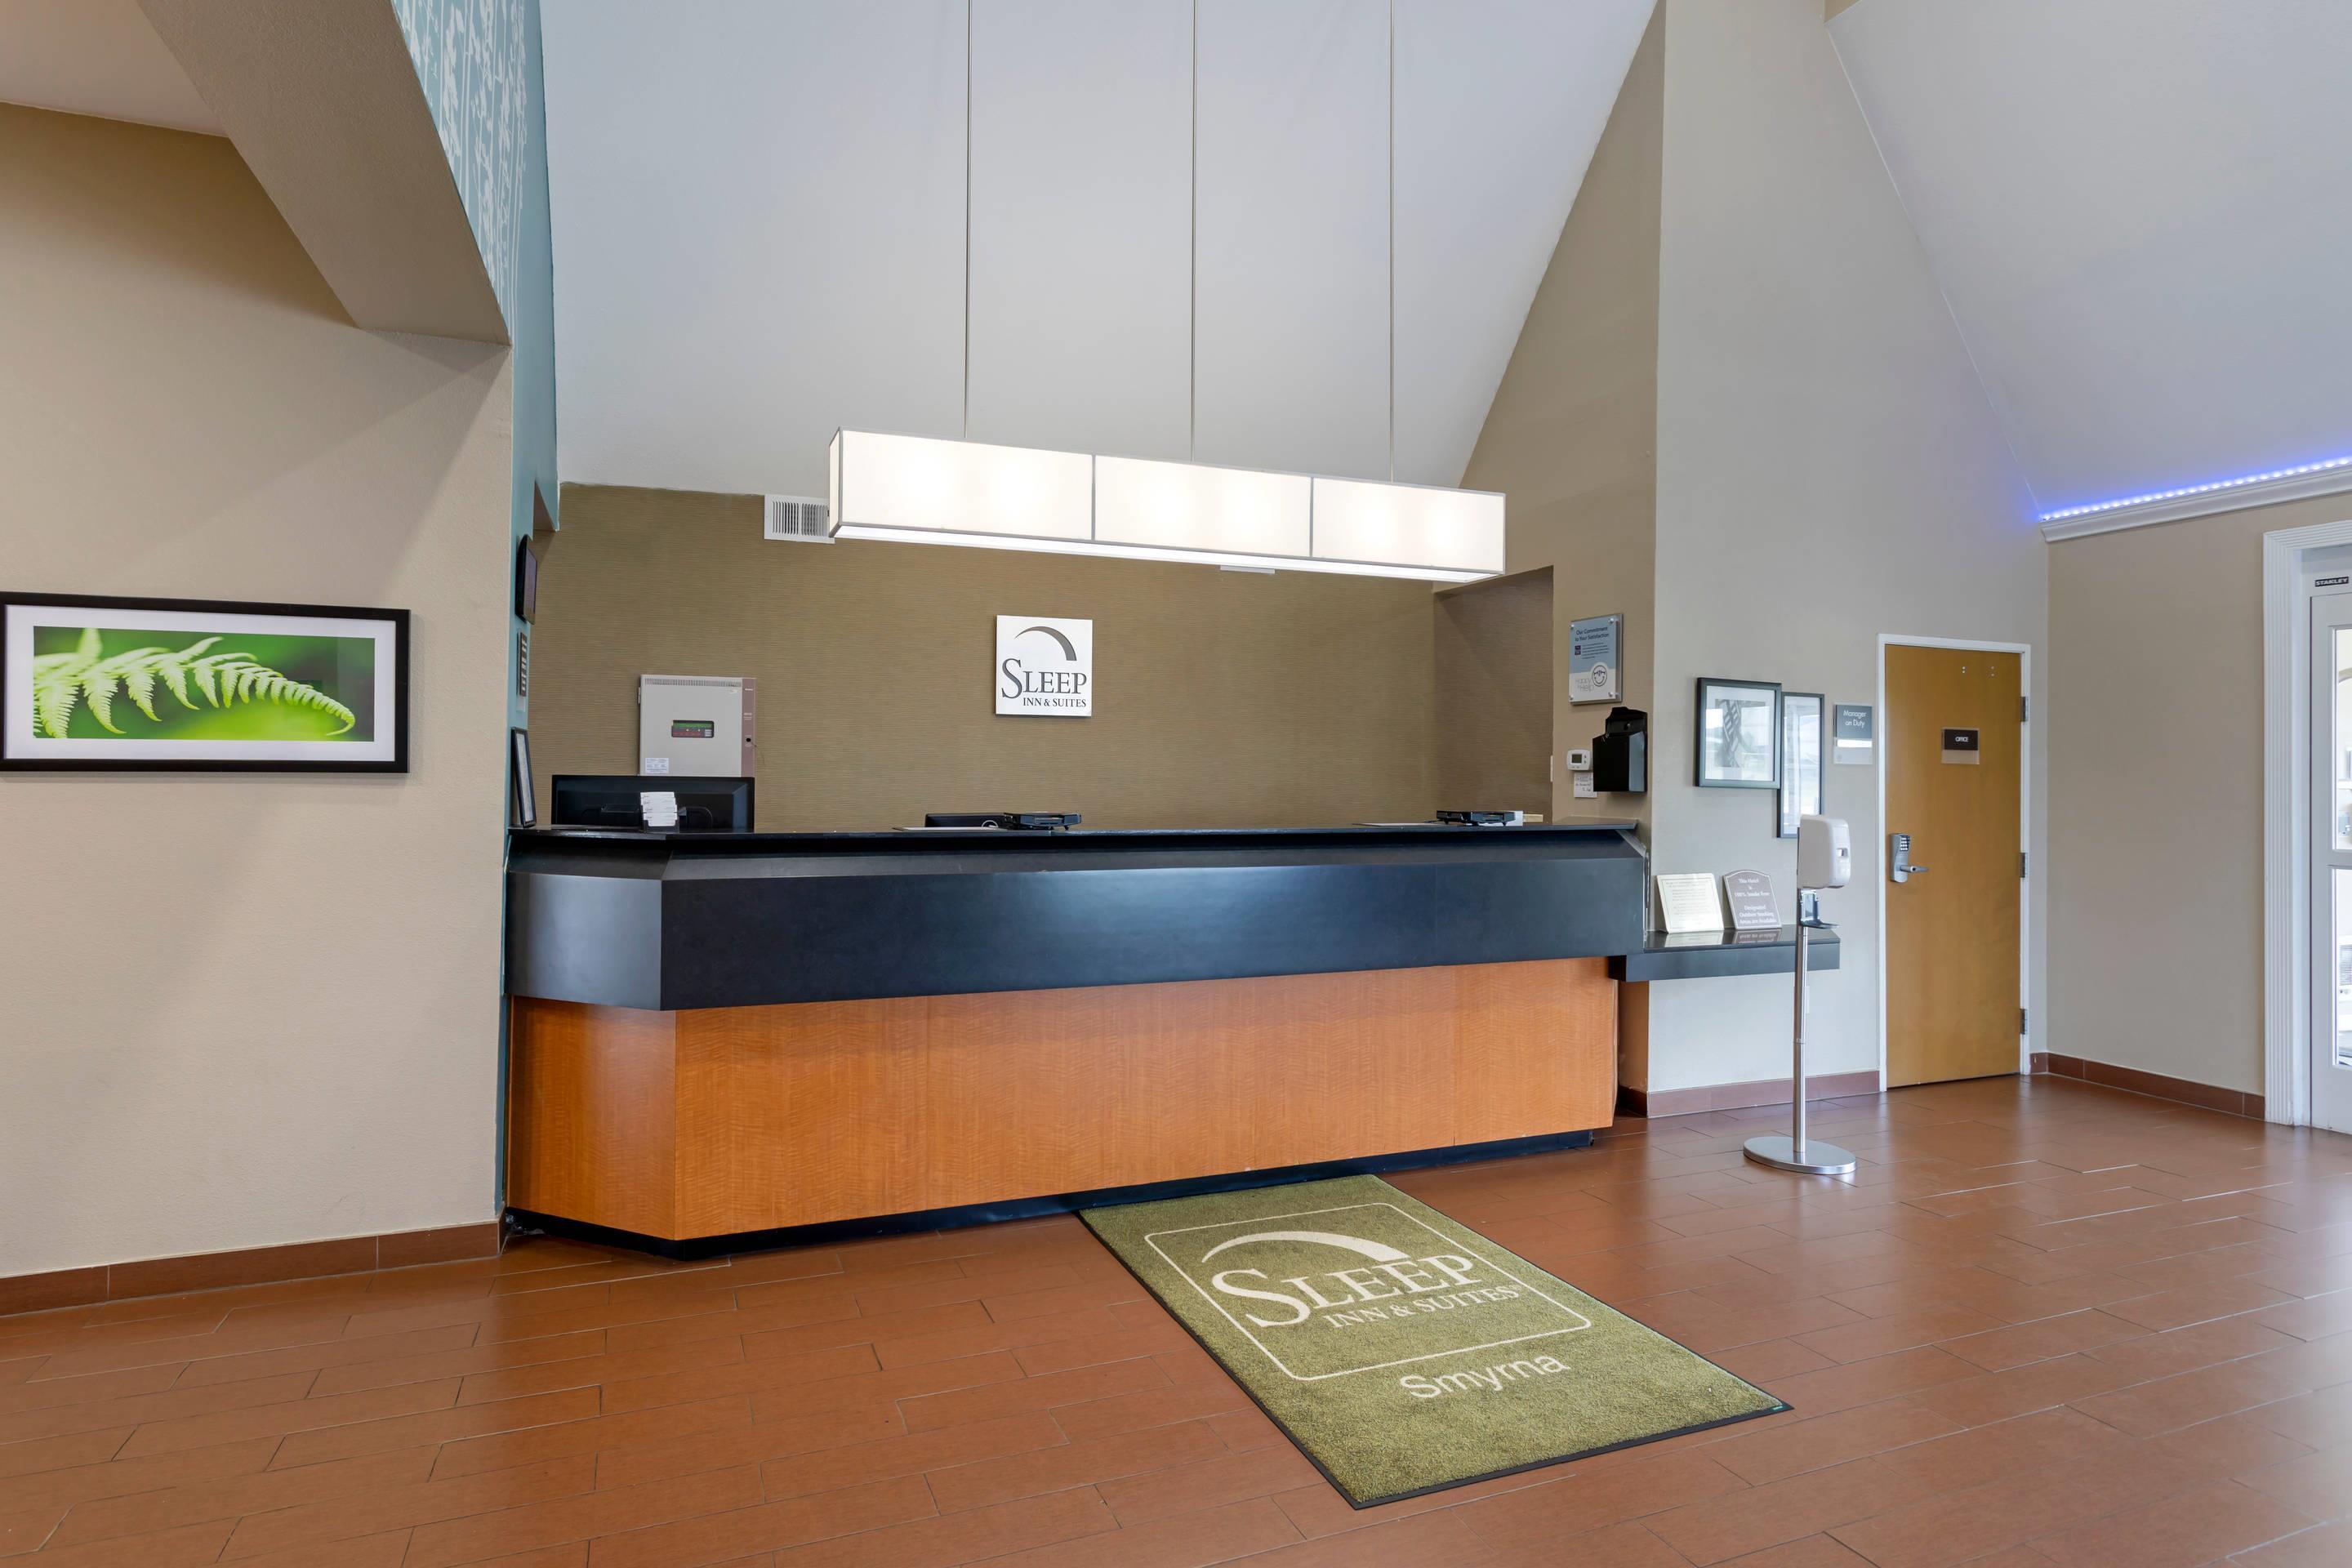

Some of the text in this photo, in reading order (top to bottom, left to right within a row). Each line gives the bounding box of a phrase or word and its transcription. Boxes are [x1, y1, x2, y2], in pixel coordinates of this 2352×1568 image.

[1001, 657, 1087, 699] SLEEP
[1022, 697, 1087, 707] INN & SUITES
[1842, 710, 1867, 719] Manager
[1853, 719, 1865, 728] Duty
[1211, 1254, 1482, 1328] SLEEP
[1323, 1285, 1519, 1328] INN & SUITES
[1400, 1355, 1571, 1398] Smyrna
